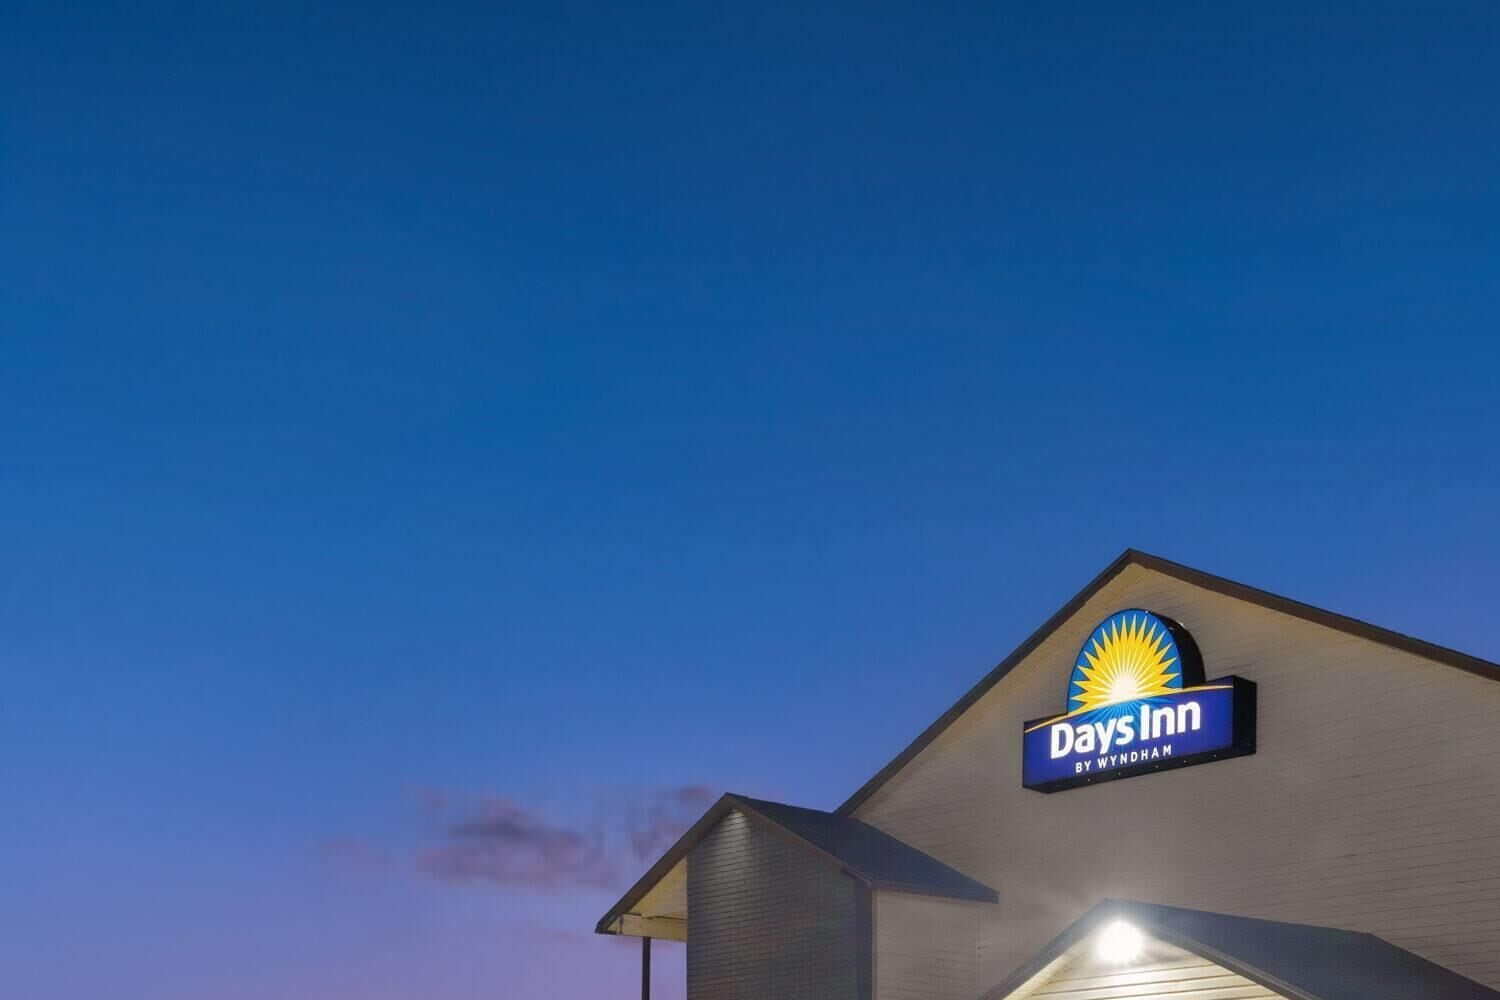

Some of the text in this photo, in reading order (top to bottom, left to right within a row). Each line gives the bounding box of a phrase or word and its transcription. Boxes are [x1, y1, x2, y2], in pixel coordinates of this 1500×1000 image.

[1051, 701, 1201, 759] Days Inn
[1075, 744, 1172, 773] BY WYNDHAM
